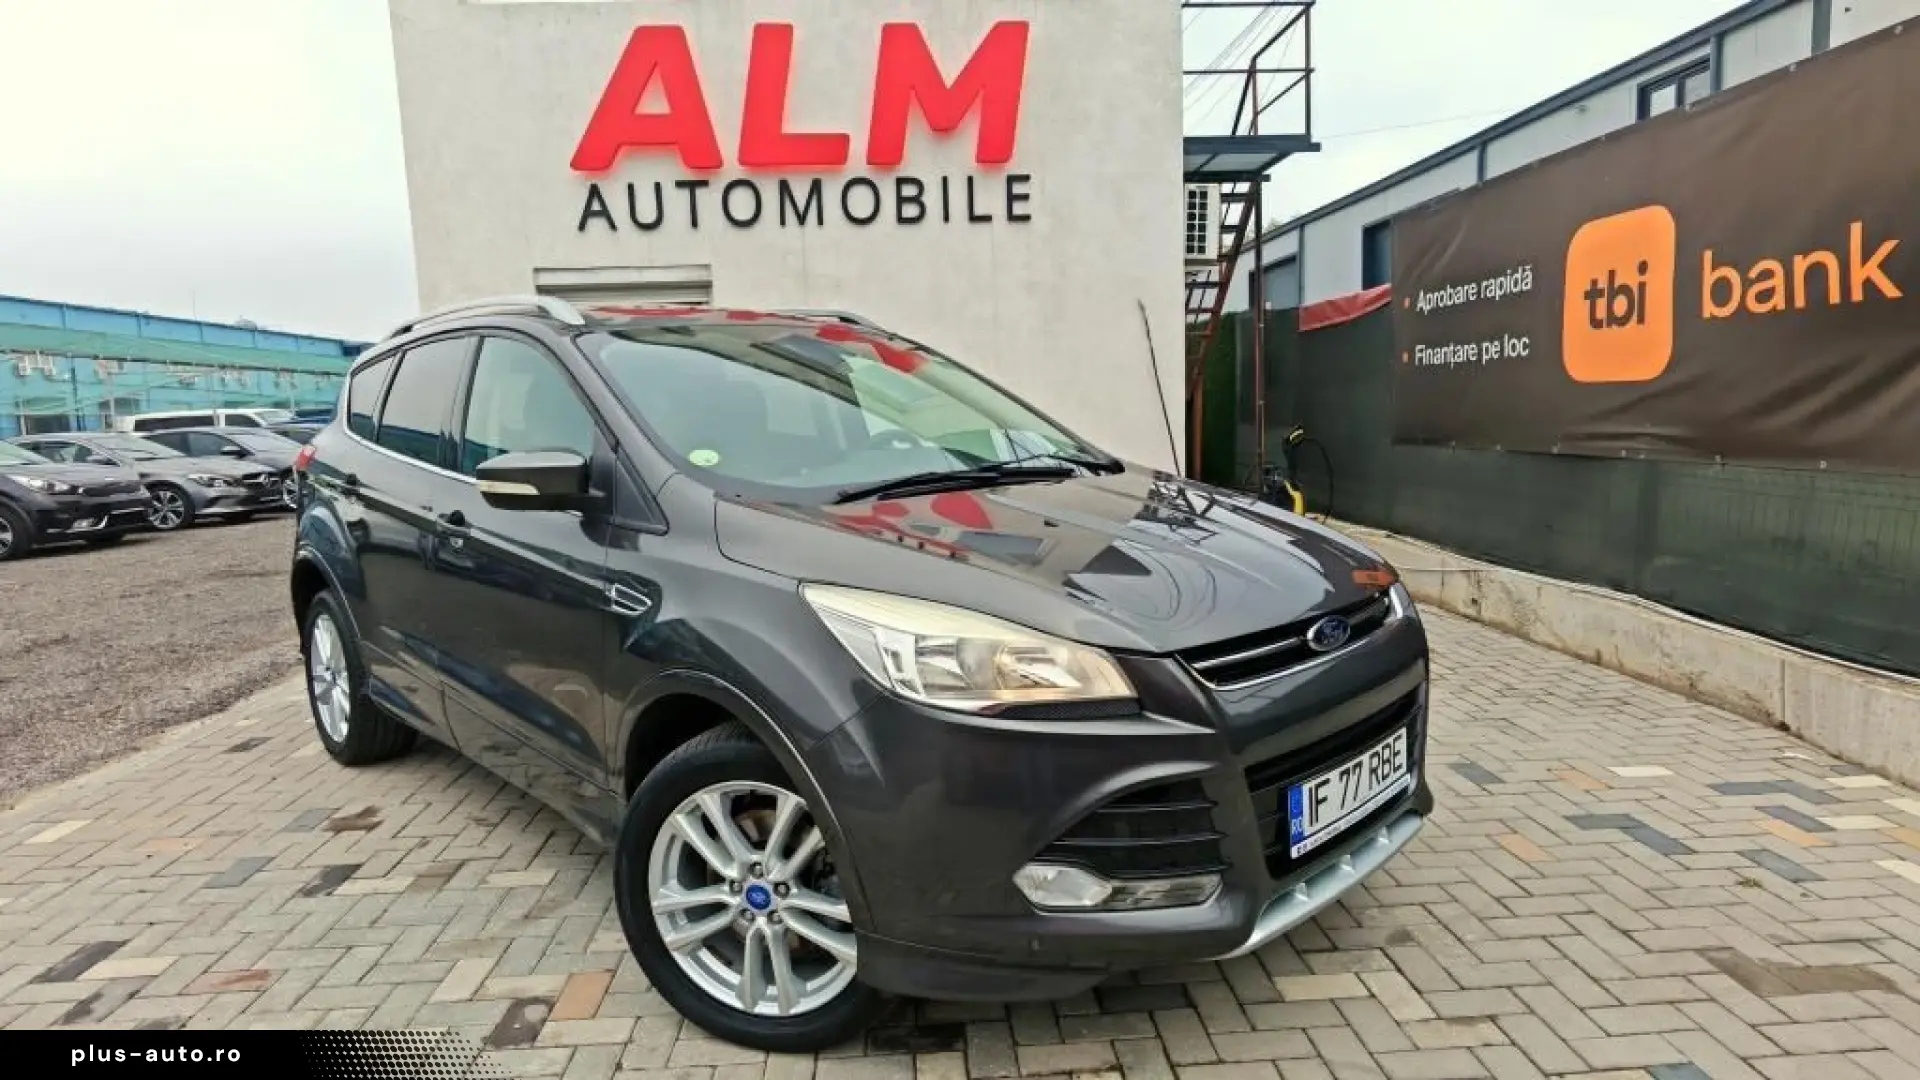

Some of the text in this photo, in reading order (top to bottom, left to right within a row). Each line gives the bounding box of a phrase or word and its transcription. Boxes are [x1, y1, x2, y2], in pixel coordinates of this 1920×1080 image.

[569, 20, 1030, 170] ALM
[578, 173, 1032, 232] AUTOMOBILE
[1415, 264, 1533, 316] Aprobare rapidă
[1584, 219, 1904, 331] tbi bank
[1482, 340, 1500, 366] pe
[1503, 333, 1530, 358] loc
[1308, 733, 1403, 828] IF 77 RBE
